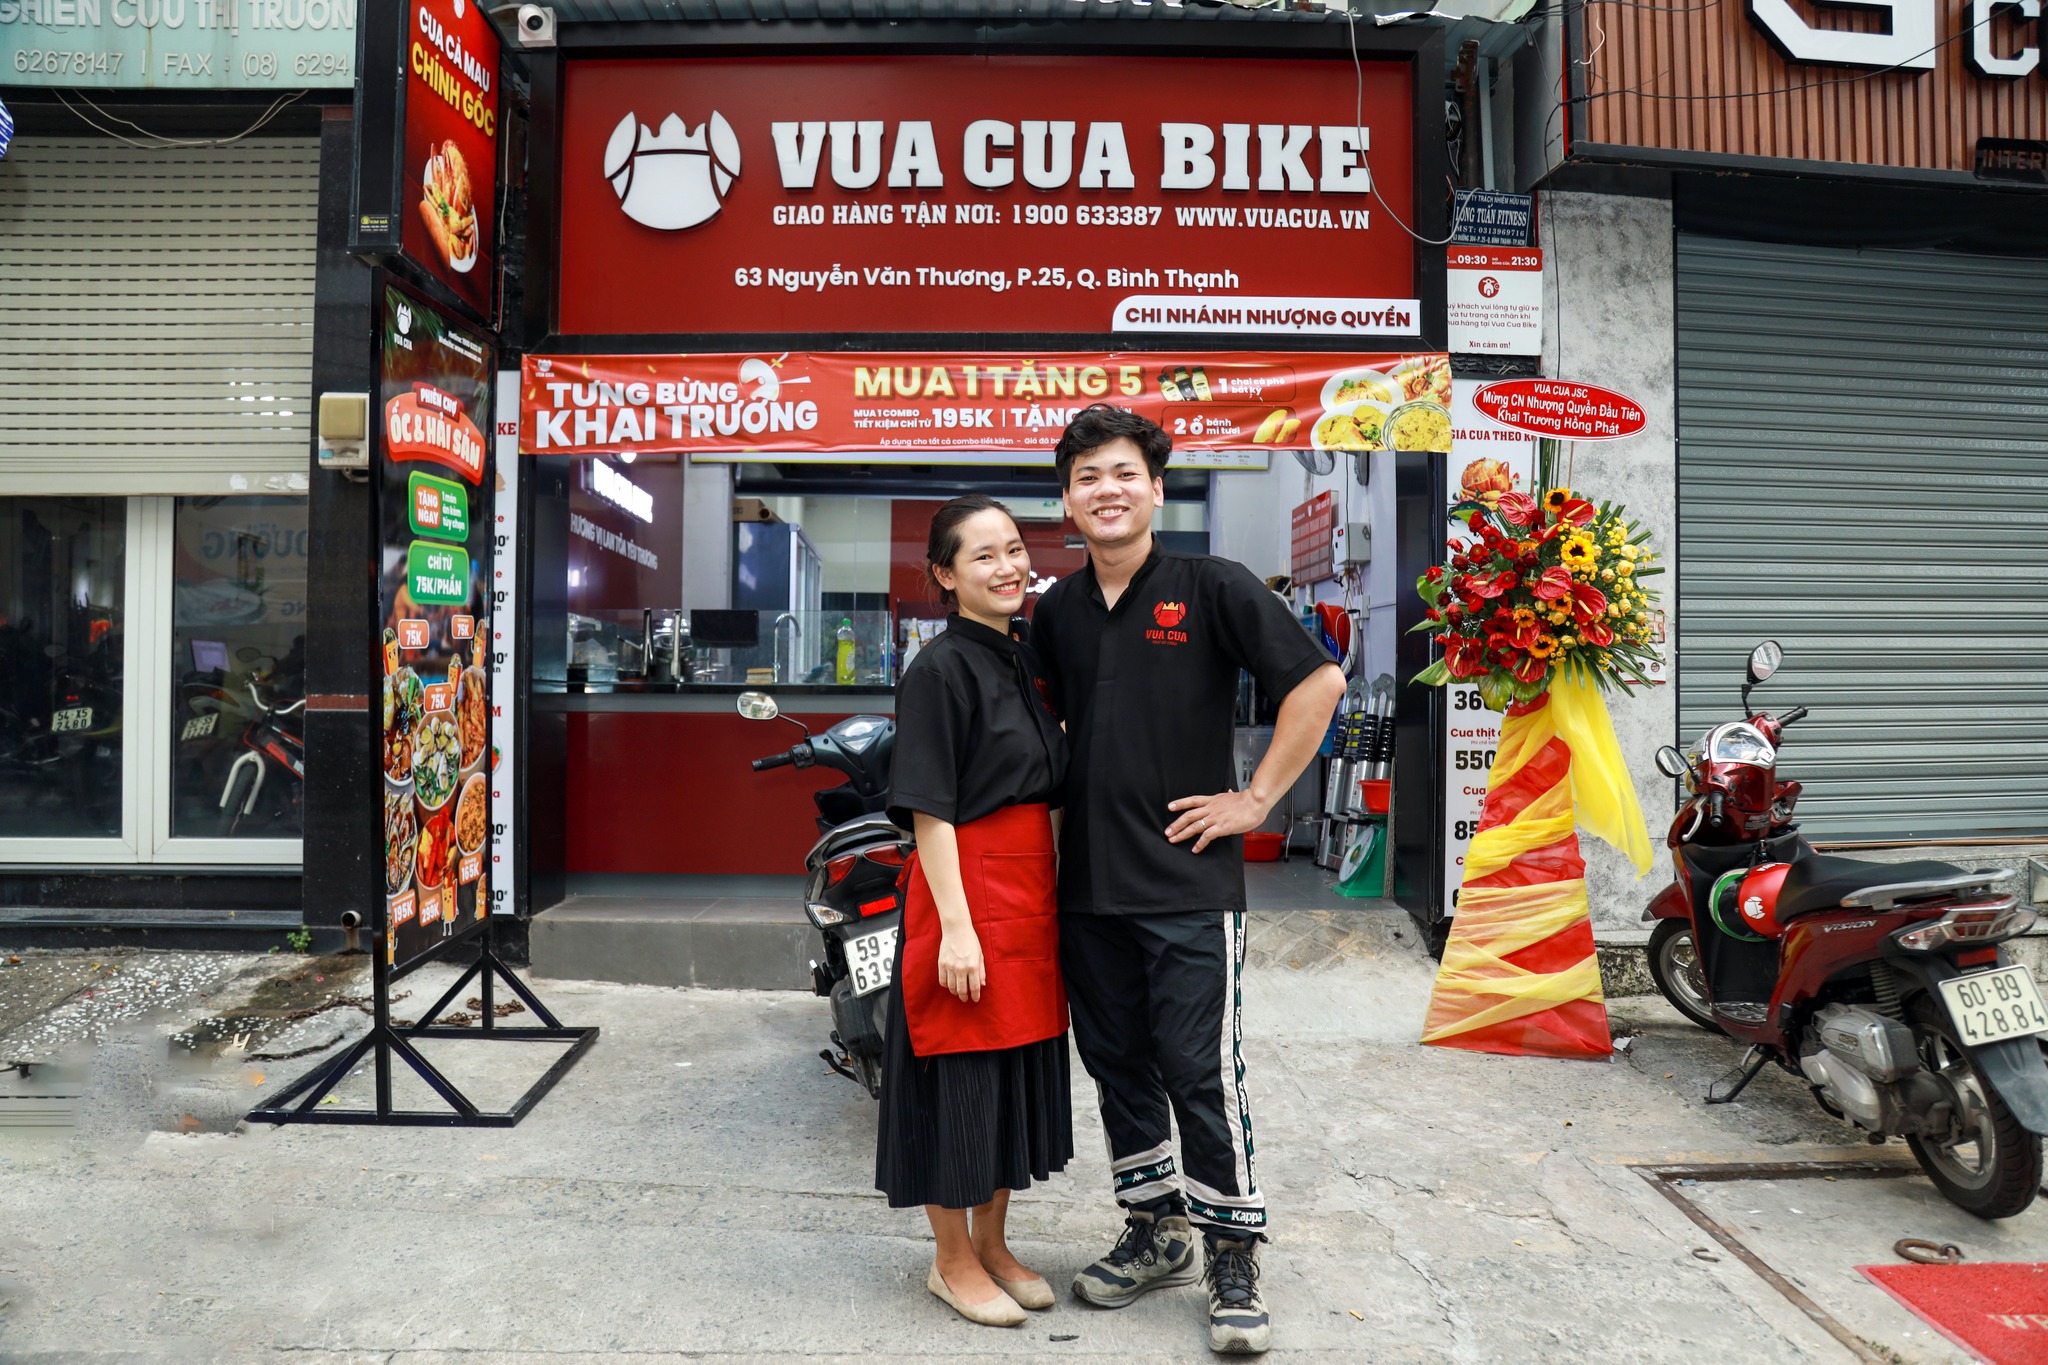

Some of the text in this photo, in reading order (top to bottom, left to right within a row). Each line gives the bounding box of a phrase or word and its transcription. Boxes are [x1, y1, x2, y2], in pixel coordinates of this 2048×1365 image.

[419, 6, 444, 52] CUA
[464, 50, 490, 92] MAU
[14, 50, 349, 81] 62678147 FAX (08) 6294
[412, 42, 494, 137] CHÍNH GỐC
[772, 119, 1371, 193] VUA CUA BIKE
[773, 200, 1370, 230] GIAO HÀNG TẬN NƠI: 1900 633387 WWW.VUACUA.VN
[1477, 204, 1496, 224] TUẤN
[1496, 210, 1528, 227] FITNESS
[1457, 255, 1487, 265] 09:30
[1511, 256, 1538, 266] 21:30
[734, 263, 1239, 293] 63 Nguyễn Văn Thương, P.25, Q. Bình Thạnh
[1125, 304, 1411, 329] CHI NHÁNH NHƯỢNG QUYỀN
[1493, 303, 1508, 312] lòng
[1460, 320, 1479, 328] hàng
[854, 358, 1143, 401] MUA 1 TẶNG 5
[1218, 377, 1286, 394] 1 chai cà phê
[546, 376, 738, 408] TƯNG BỪNG
[1231, 385, 1248, 394] bất
[1534, 383, 1589, 399] VUA CUA JSC
[854, 409, 877, 418] MUA
[882, 409, 920, 418] COMBO
[1482, 391, 1641, 422] Mừng CN Nhượng Quyền Đầu Tiên
[536, 407, 657, 449] KHAI
[853, 408, 993, 430] TIẾT KIỆM CHỈ TỪ 195K
[1174, 415, 1232, 435] 2 ổ bánh
[1497, 407, 1620, 435] Khai Trương Hồng Phát
[390, 400, 480, 470] ỐC & HẢI SẢN
[879, 437, 891, 446] Áp
[892, 437, 912, 447] dụng
[952, 437, 978, 445] combo
[995, 437, 1014, 447] kiệm
[1024, 436, 1039, 445] Giá
[1451, 428, 1522, 442] GIÁ CUA THEO
[418, 490, 438, 509] TẶNG
[418, 508, 438, 525] NGAY
[406, 630, 422, 645] 75K
[457, 624, 470, 637] 75K
[1146, 629, 1188, 642] VUA CUA
[431, 694, 446, 710] 75K
[1451, 728, 1473, 738] Cua
[1476, 727, 1496, 740] thịt
[1463, 786, 1486, 796] Cua
[461, 862, 480, 881] 165K
[394, 900, 413, 923] 195K
[422, 902, 440, 923] 299K
[1822, 920, 1878, 933] VISION
[1957, 973, 2023, 1008] 60-B9
[1963, 1001, 2045, 1040] 428.84
[1231, 1209, 1263, 1225] Kappa
